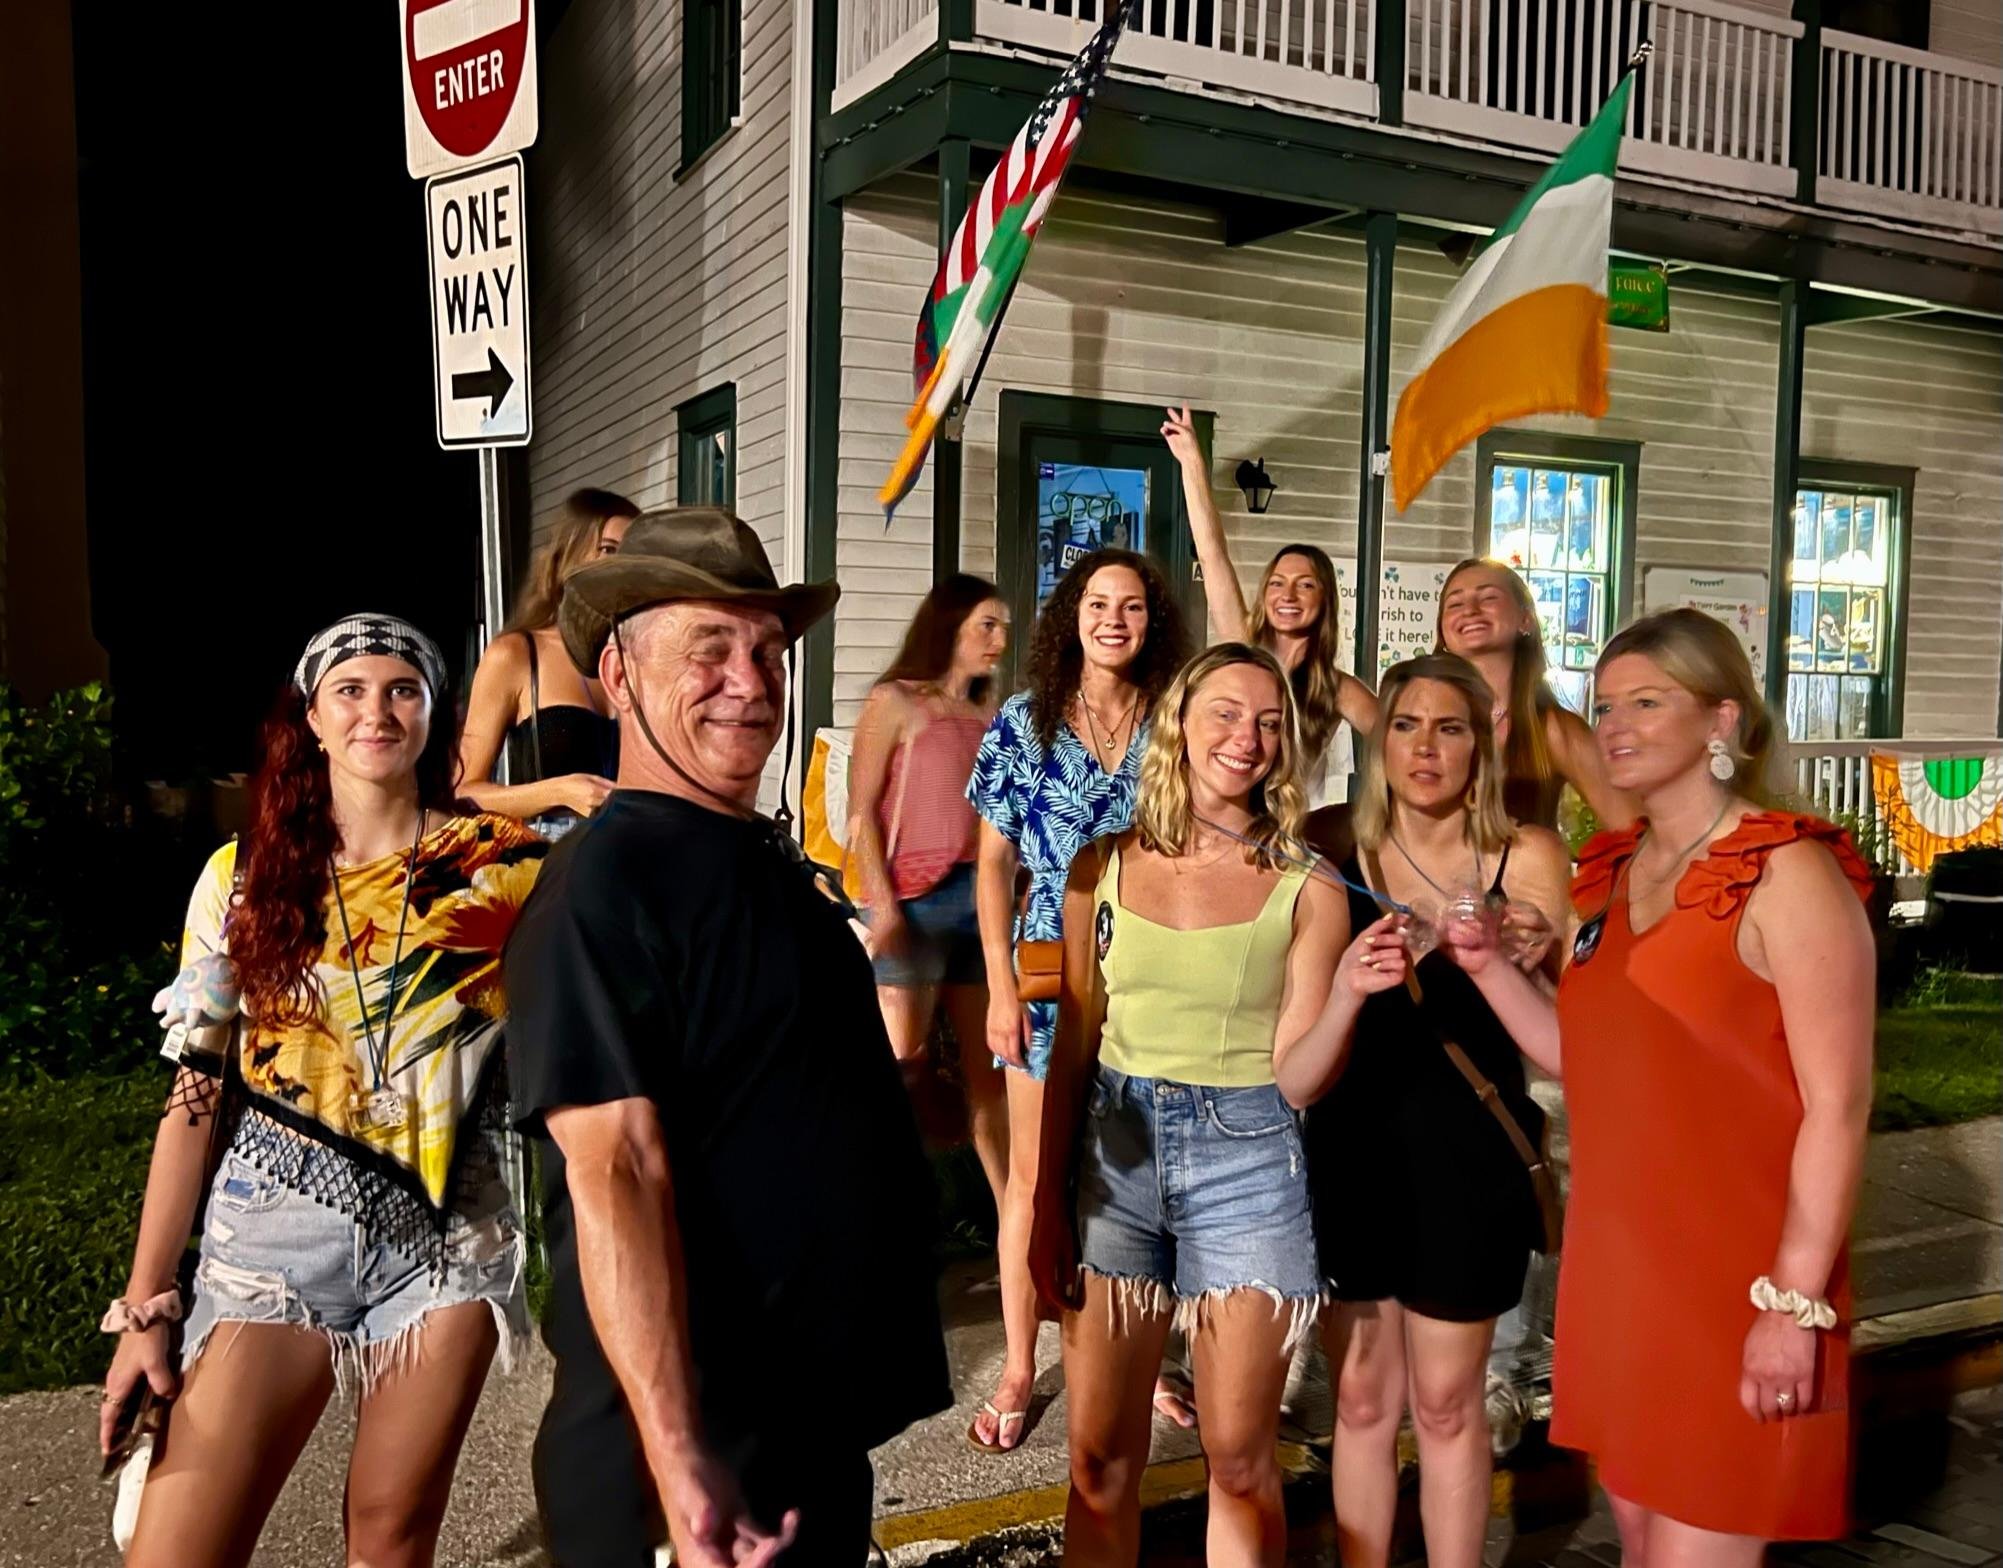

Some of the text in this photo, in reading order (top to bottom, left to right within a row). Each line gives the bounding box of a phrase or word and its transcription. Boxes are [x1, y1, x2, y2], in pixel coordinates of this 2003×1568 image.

[435, 49, 505, 110] ENTER
[442, 185, 513, 260] ONE
[443, 264, 516, 335] WAY
[1065, 545, 1090, 563] CLO
[1398, 586, 1430, 602] have
[1381, 607, 1424, 622] rish to
[1386, 628, 1395, 642] it
[1398, 628, 1433, 643] here!
